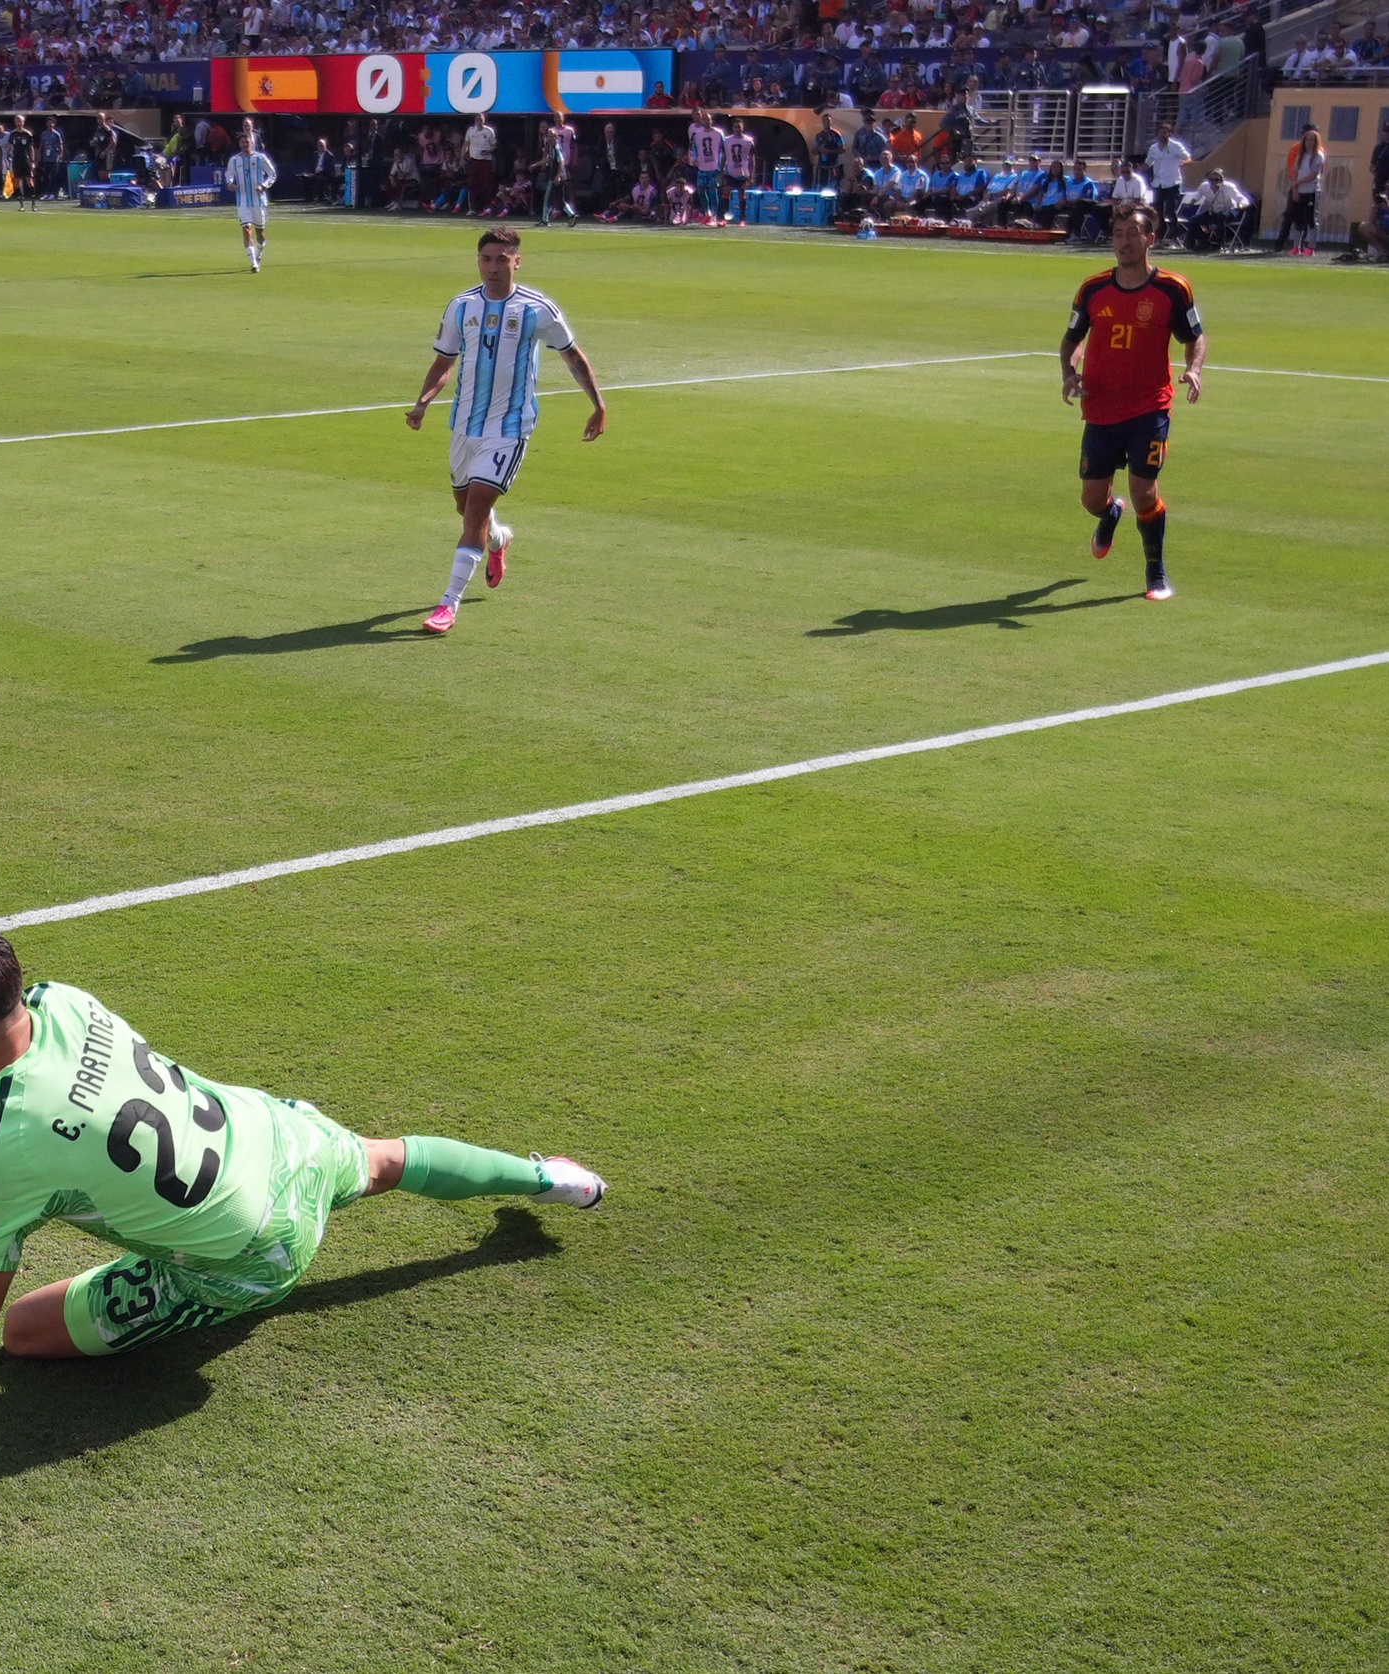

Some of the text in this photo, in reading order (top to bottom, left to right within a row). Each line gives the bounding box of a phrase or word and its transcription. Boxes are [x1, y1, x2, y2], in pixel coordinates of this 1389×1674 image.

[144, 73, 180, 91] NAL
[356, 52, 497, 114] 0 0
[482, 334, 496, 359] 4
[1110, 325, 1133, 349] 21
[492, 451, 506, 476] 4
[52, 1118, 86, 1141] E.
[107, 1037, 226, 1208] 23
[103, 1259, 156, 1324] 23
